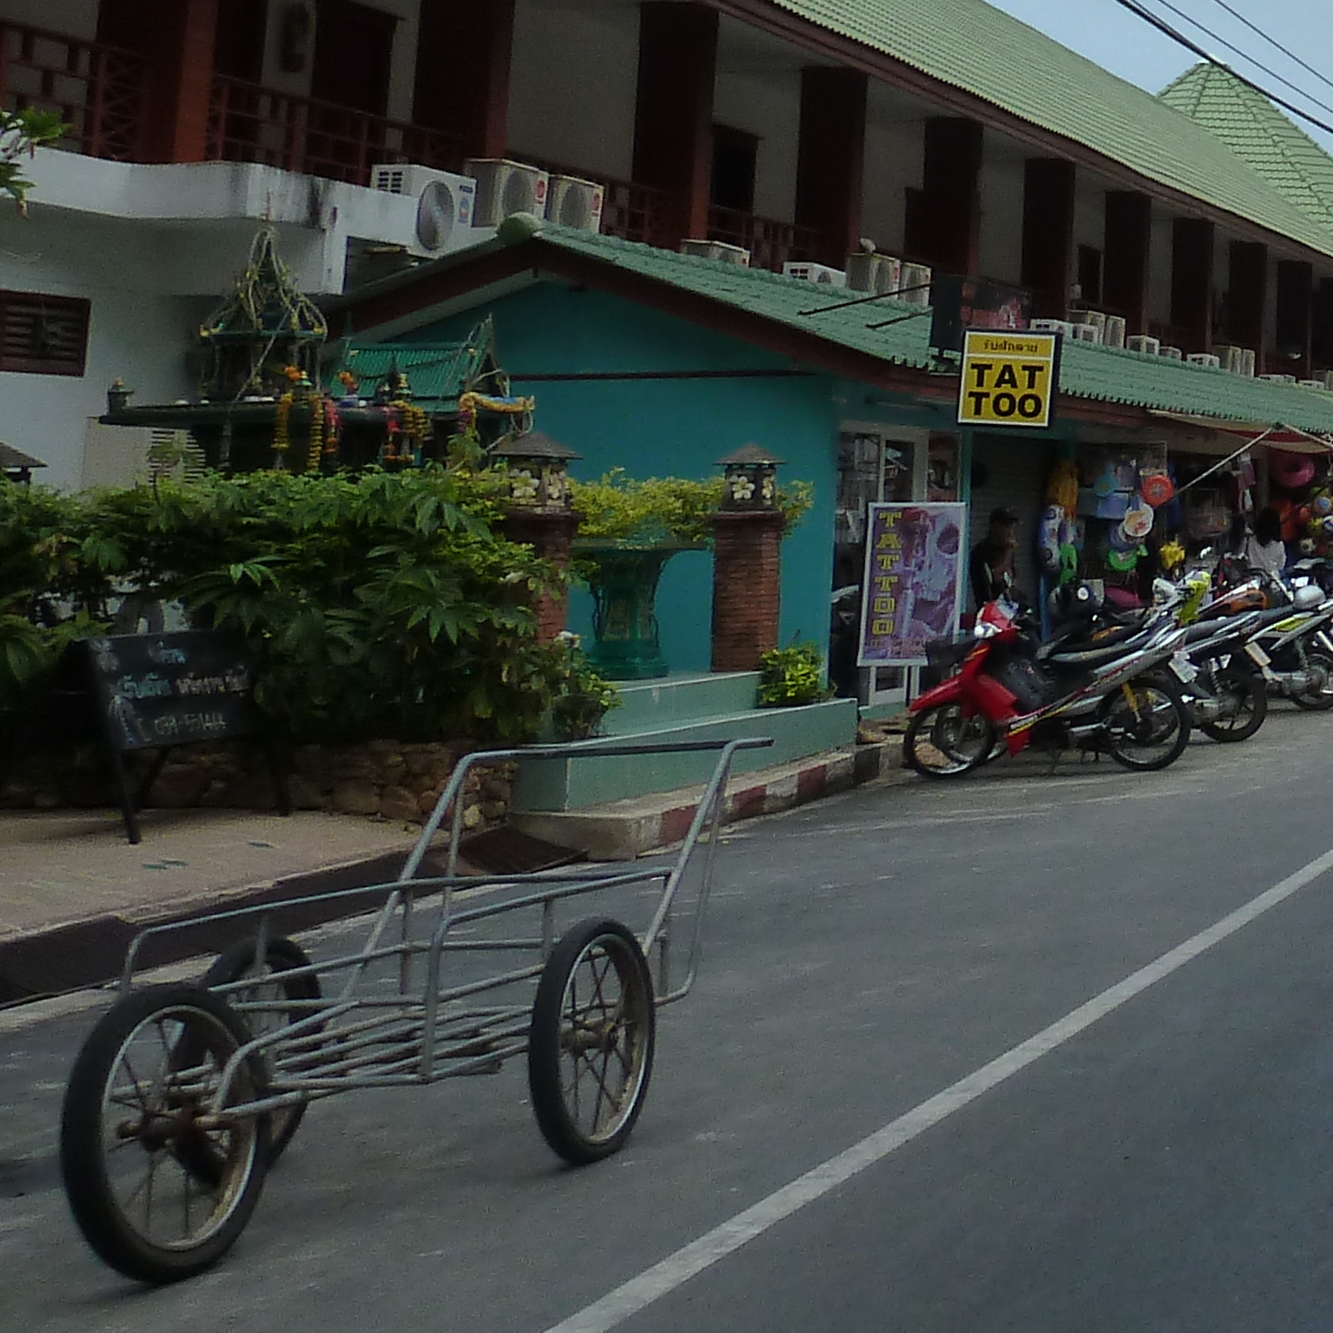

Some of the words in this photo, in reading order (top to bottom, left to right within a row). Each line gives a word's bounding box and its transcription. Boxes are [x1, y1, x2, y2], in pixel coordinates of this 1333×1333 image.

[970, 363, 1044, 389] TAT
[968, 391, 1042, 418] TOO
[871, 511, 902, 636] TATTOO
